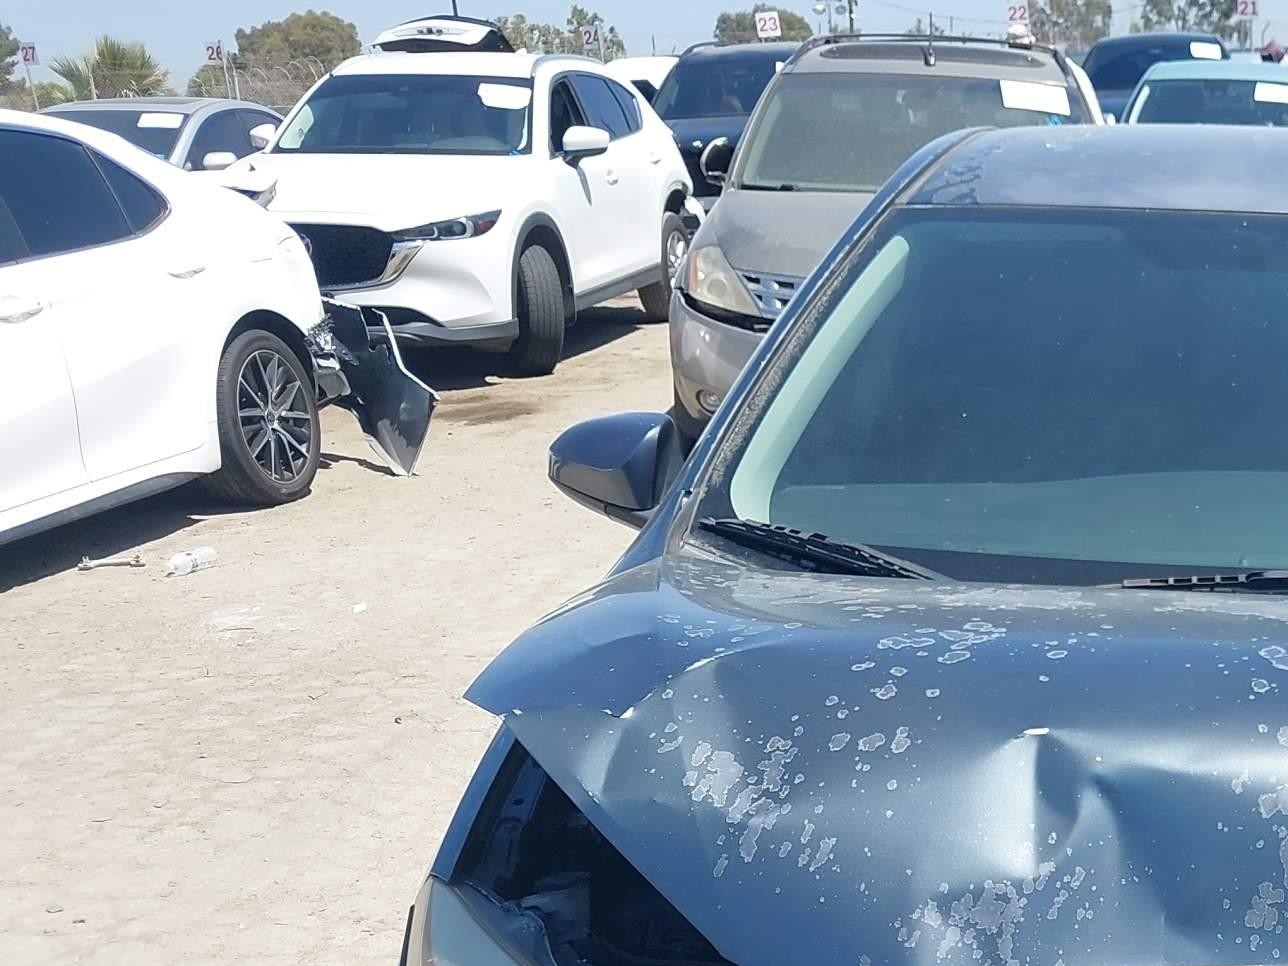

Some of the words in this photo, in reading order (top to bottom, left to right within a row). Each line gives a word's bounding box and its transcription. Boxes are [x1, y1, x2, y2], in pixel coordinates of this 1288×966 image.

[1008, 6, 1026, 21] 22
[1239, 1, 1258, 16] 21
[758, 16, 778, 32] 23
[21, 46, 36, 62] 27
